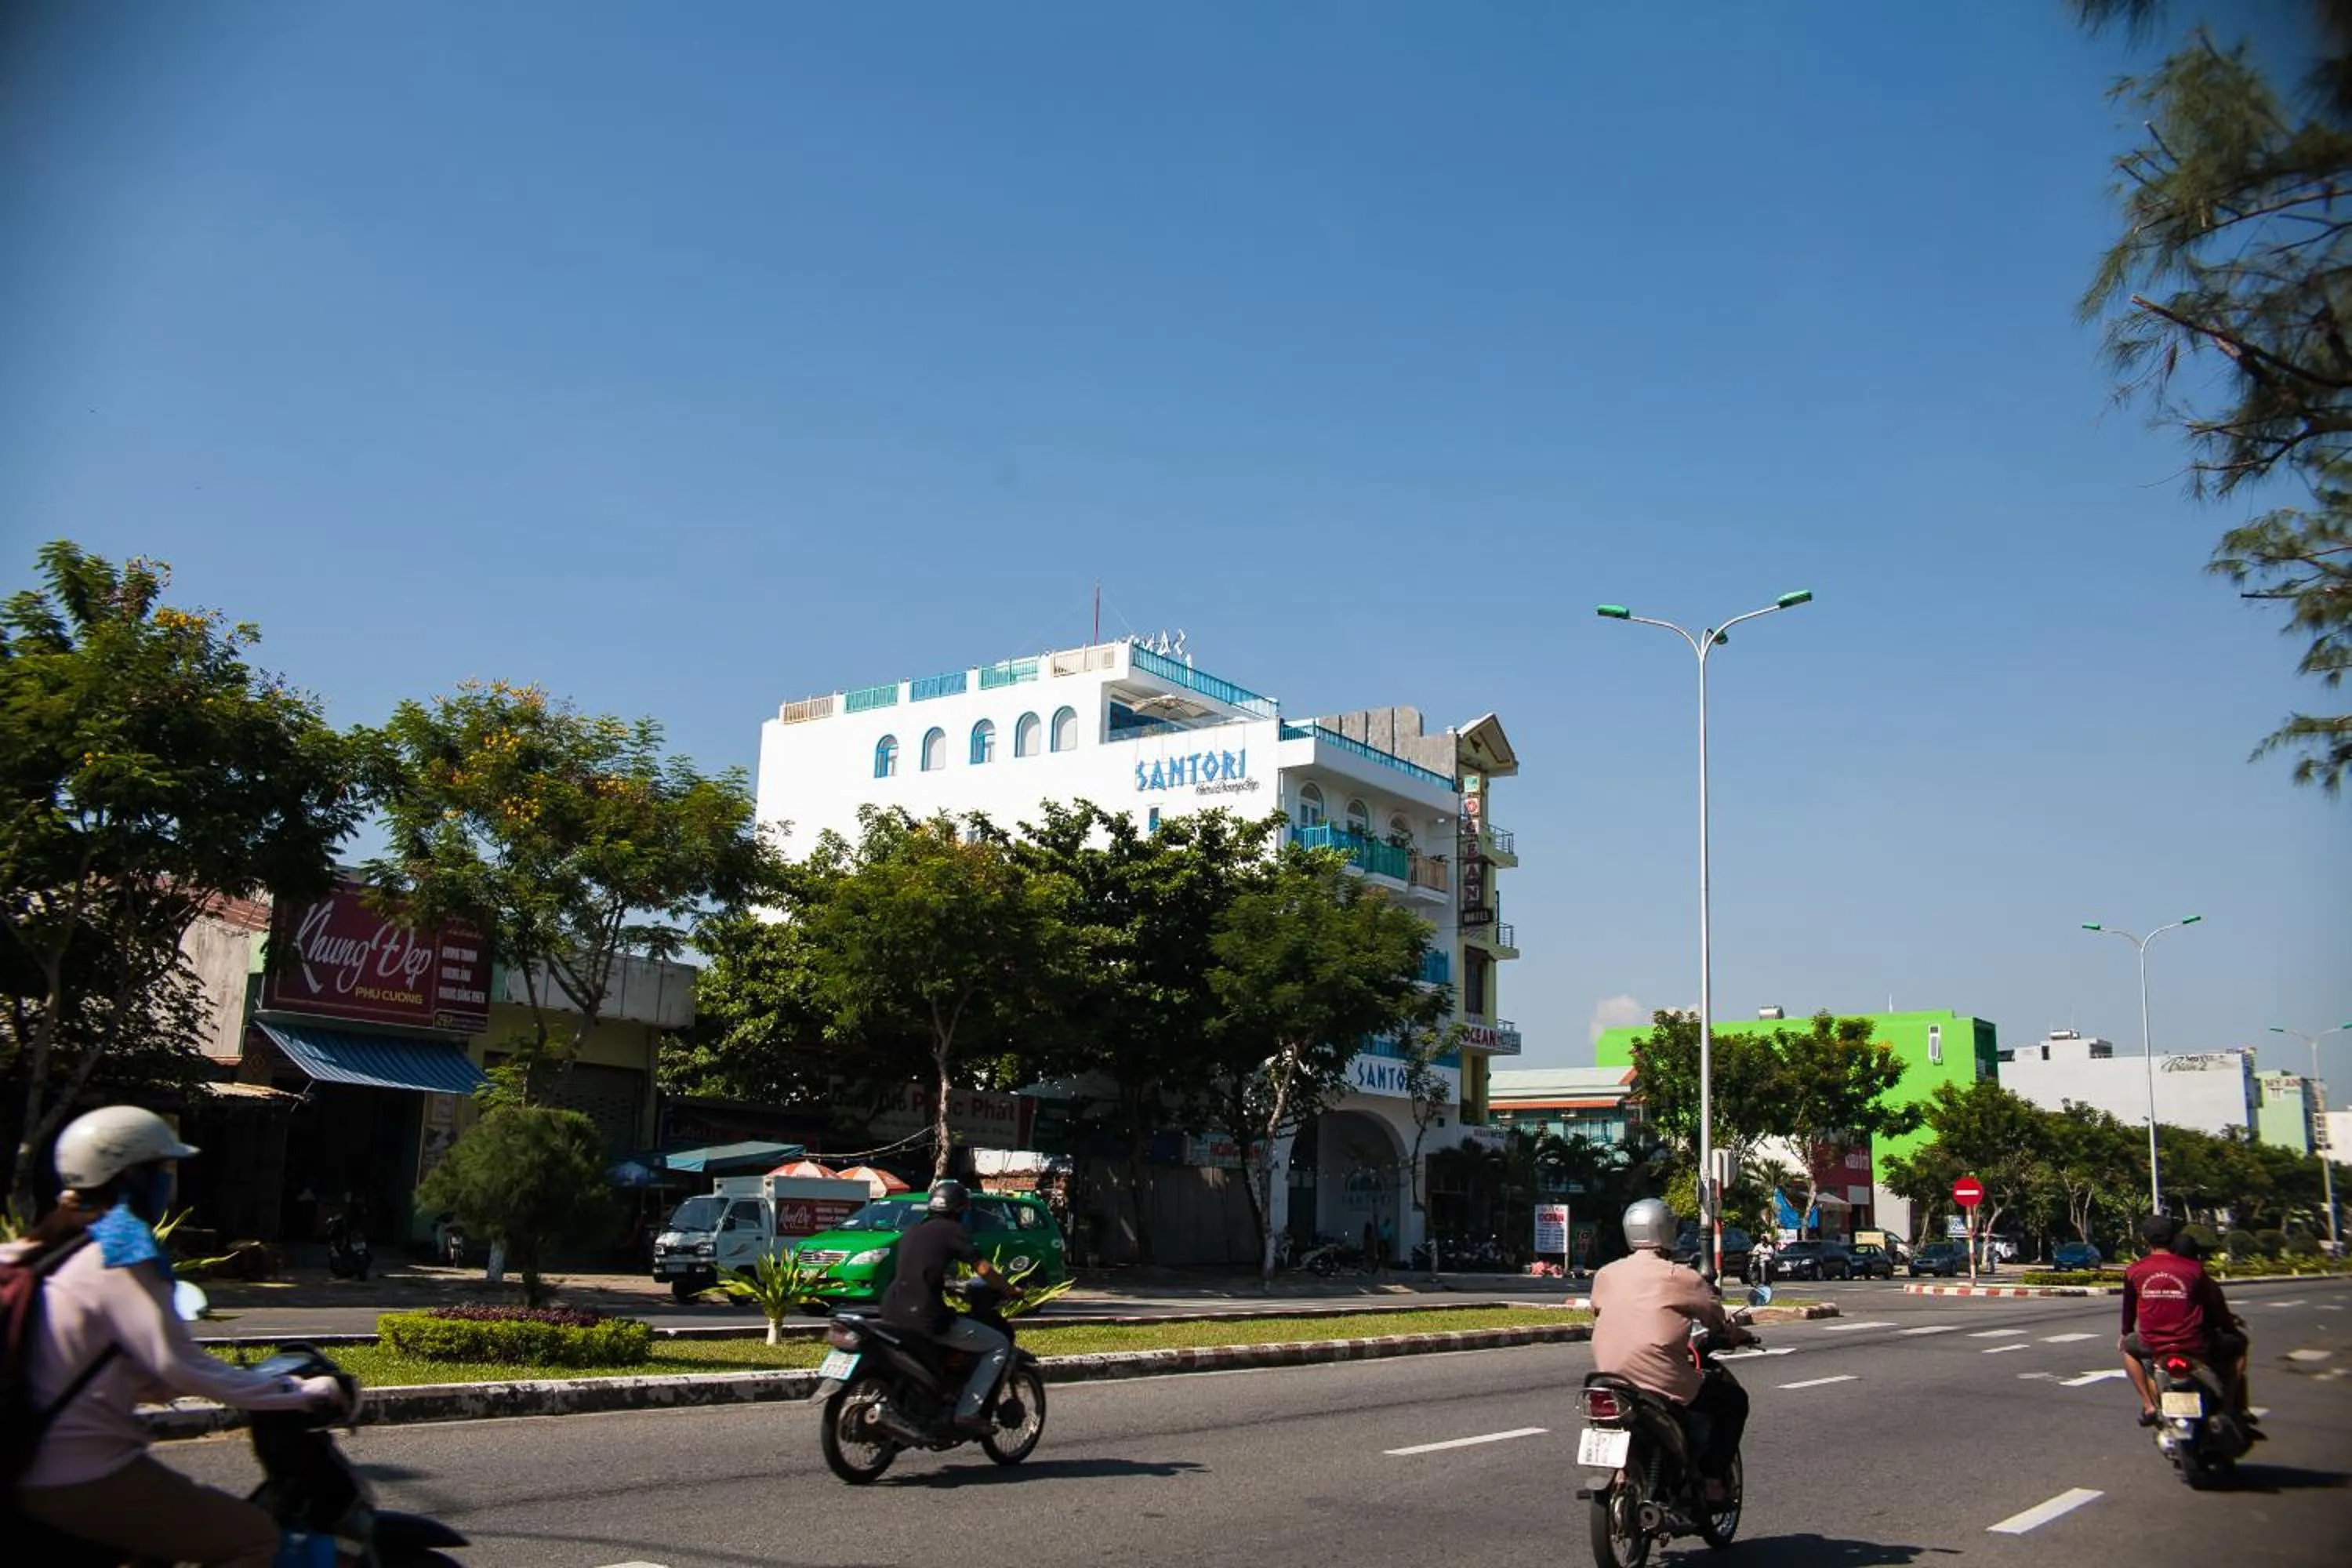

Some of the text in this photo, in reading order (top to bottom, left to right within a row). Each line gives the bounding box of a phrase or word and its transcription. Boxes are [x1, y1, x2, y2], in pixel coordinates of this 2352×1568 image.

[1135, 748, 1246, 792] SANTORI
[291, 899, 369, 994] Khung
[1461, 1028, 1496, 1047] OCEAN
[1357, 1061, 1411, 1093] SANTO
